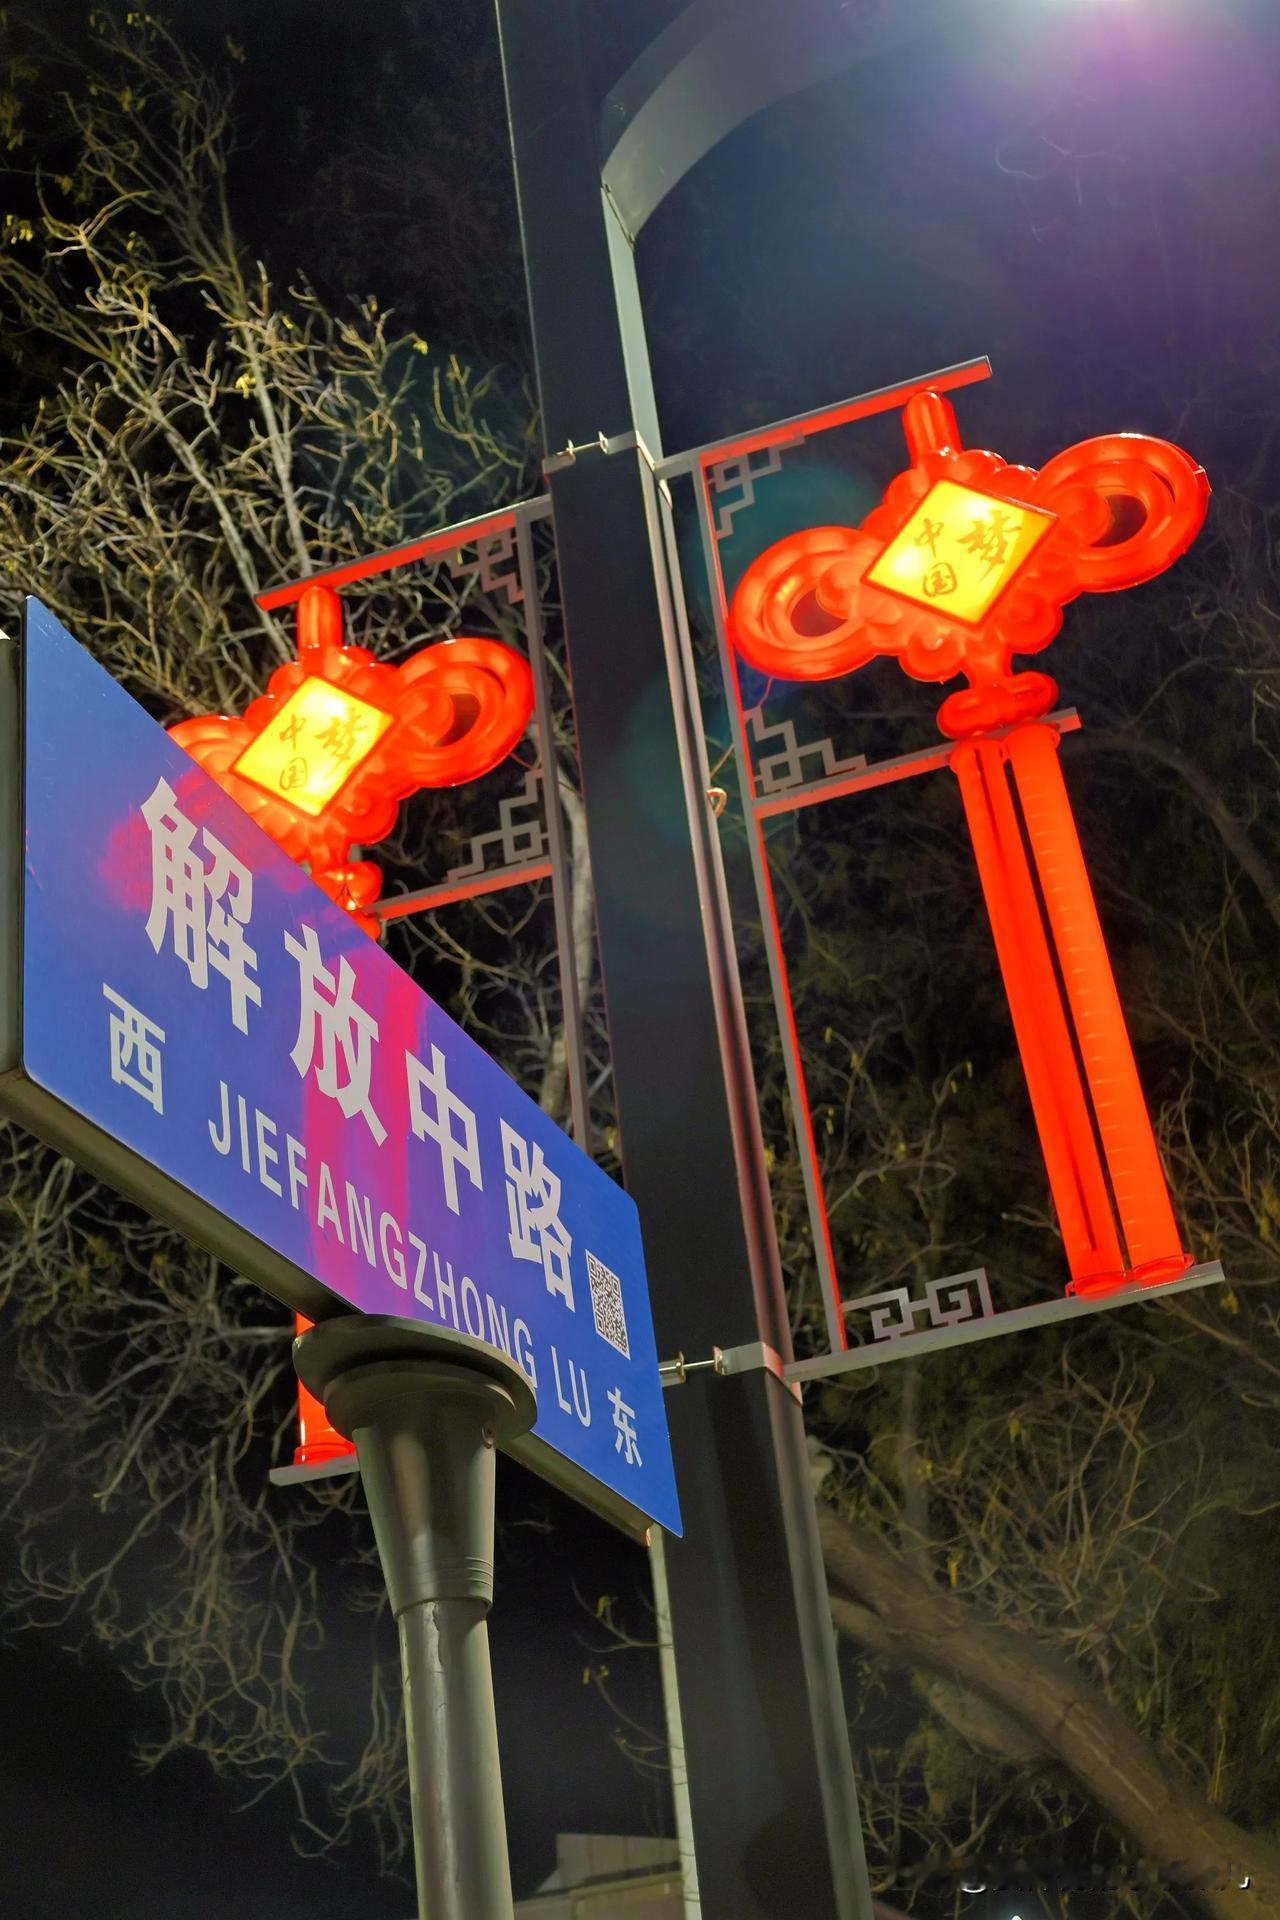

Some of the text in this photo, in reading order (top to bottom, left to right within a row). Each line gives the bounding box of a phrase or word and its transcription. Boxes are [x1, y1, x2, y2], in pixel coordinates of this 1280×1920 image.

[102, 982, 166, 1115] 西
[140, 775, 576, 1313] 解放中路
[208, 1080, 592, 1428] JIEFANGZHONG LU
[607, 1386, 643, 1468] 东
